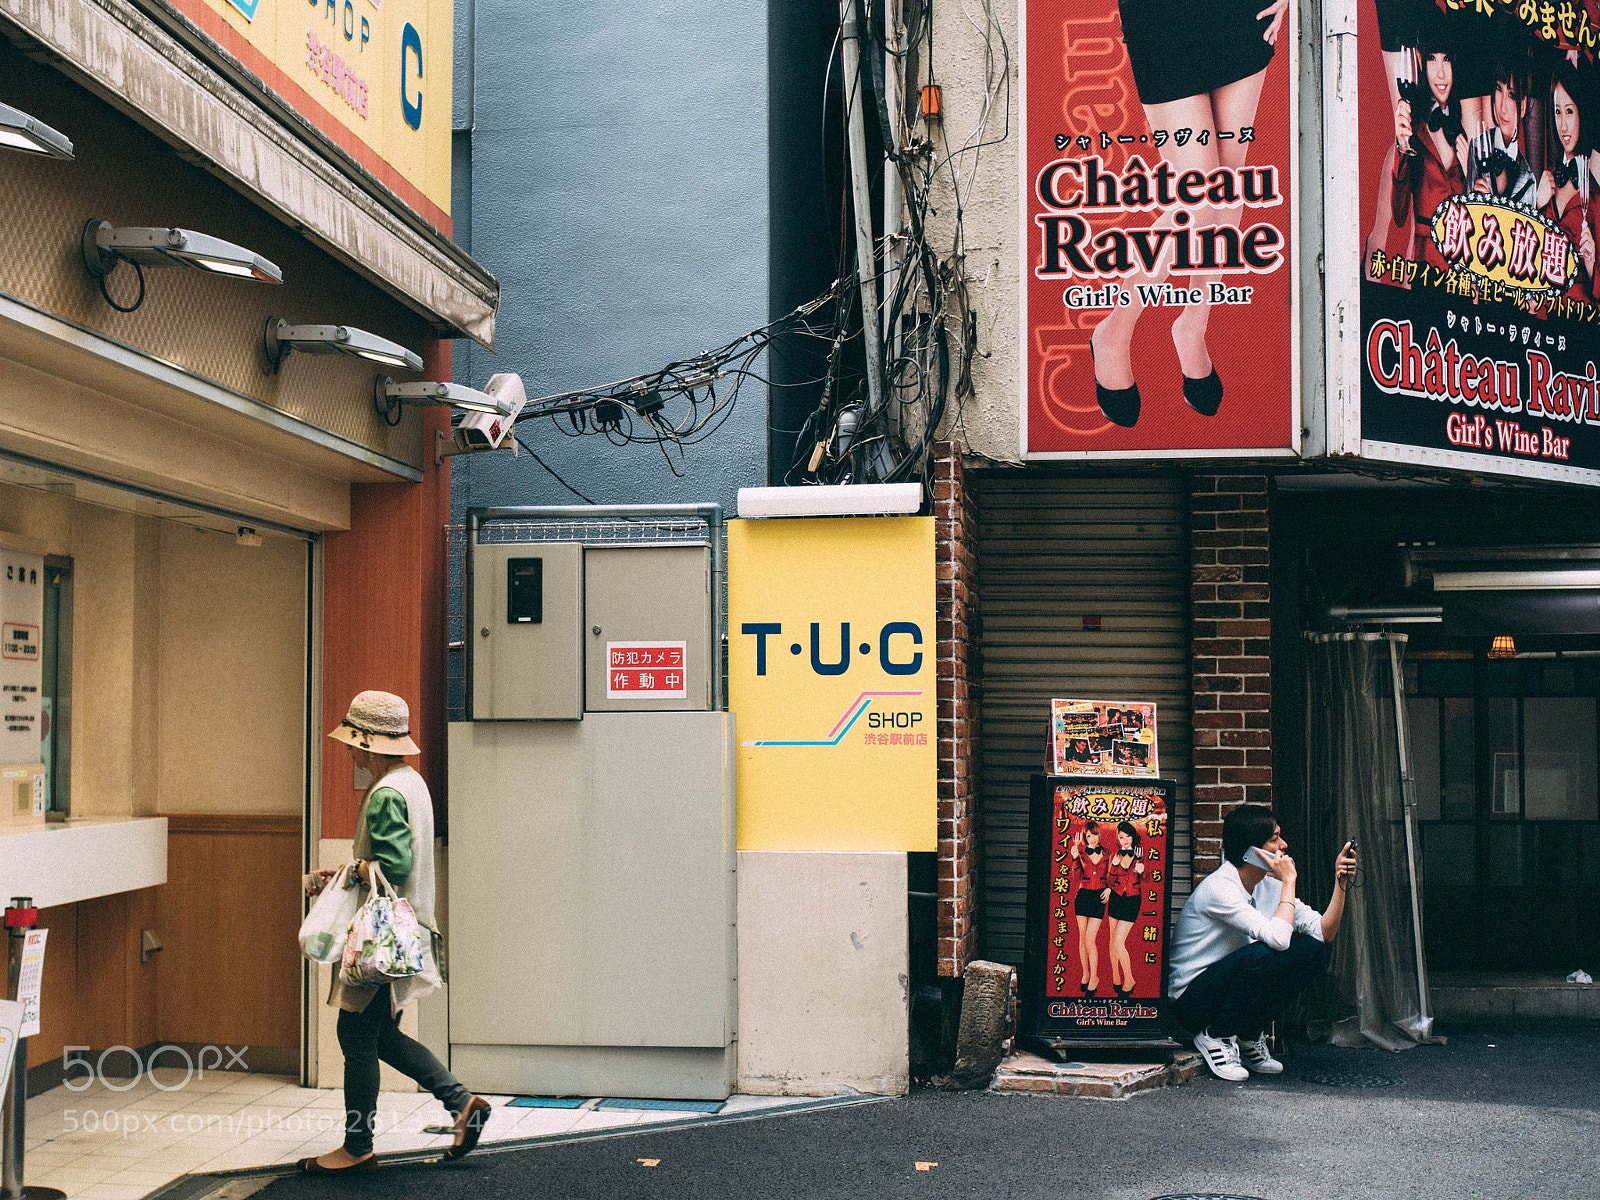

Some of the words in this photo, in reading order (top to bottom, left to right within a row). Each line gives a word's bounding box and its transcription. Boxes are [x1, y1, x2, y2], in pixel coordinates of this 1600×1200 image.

[309, 0, 370, 52] HOP
[305, 28, 369, 120] 渋谷駅前店
[400, 22, 423, 130] C
[1055, 128, 1256, 150] シャトー・ラヴィーヌ
[1036, 153, 1283, 213] Château
[1036, 209, 1284, 279] Ravine
[1442, 201, 1568, 286] 飲み放題
[1137, 284, 1203, 306] Wine
[1208, 282, 1252, 304] Bar
[1371, 250, 1600, 326] 赤・白ワイン各種、生ビール、ソフトドリン
[1367, 318, 1521, 413] Château
[1496, 418, 1540, 455] Wine
[1541, 426, 1570, 459] Bar
[612, 651, 680, 665] 防犯カメラ
[614, 672, 680, 689] 作動中
[864, 733, 928, 746] 渋谷駅前店
[868, 712, 923, 729] SHOP
[1071, 797, 1149, 816] 飲み放題
[1142, 819, 1164, 965] 私たちと一緒に
[1048, 1002, 1108, 1018] Château
[1109, 1003, 1158, 1018] Ravine
